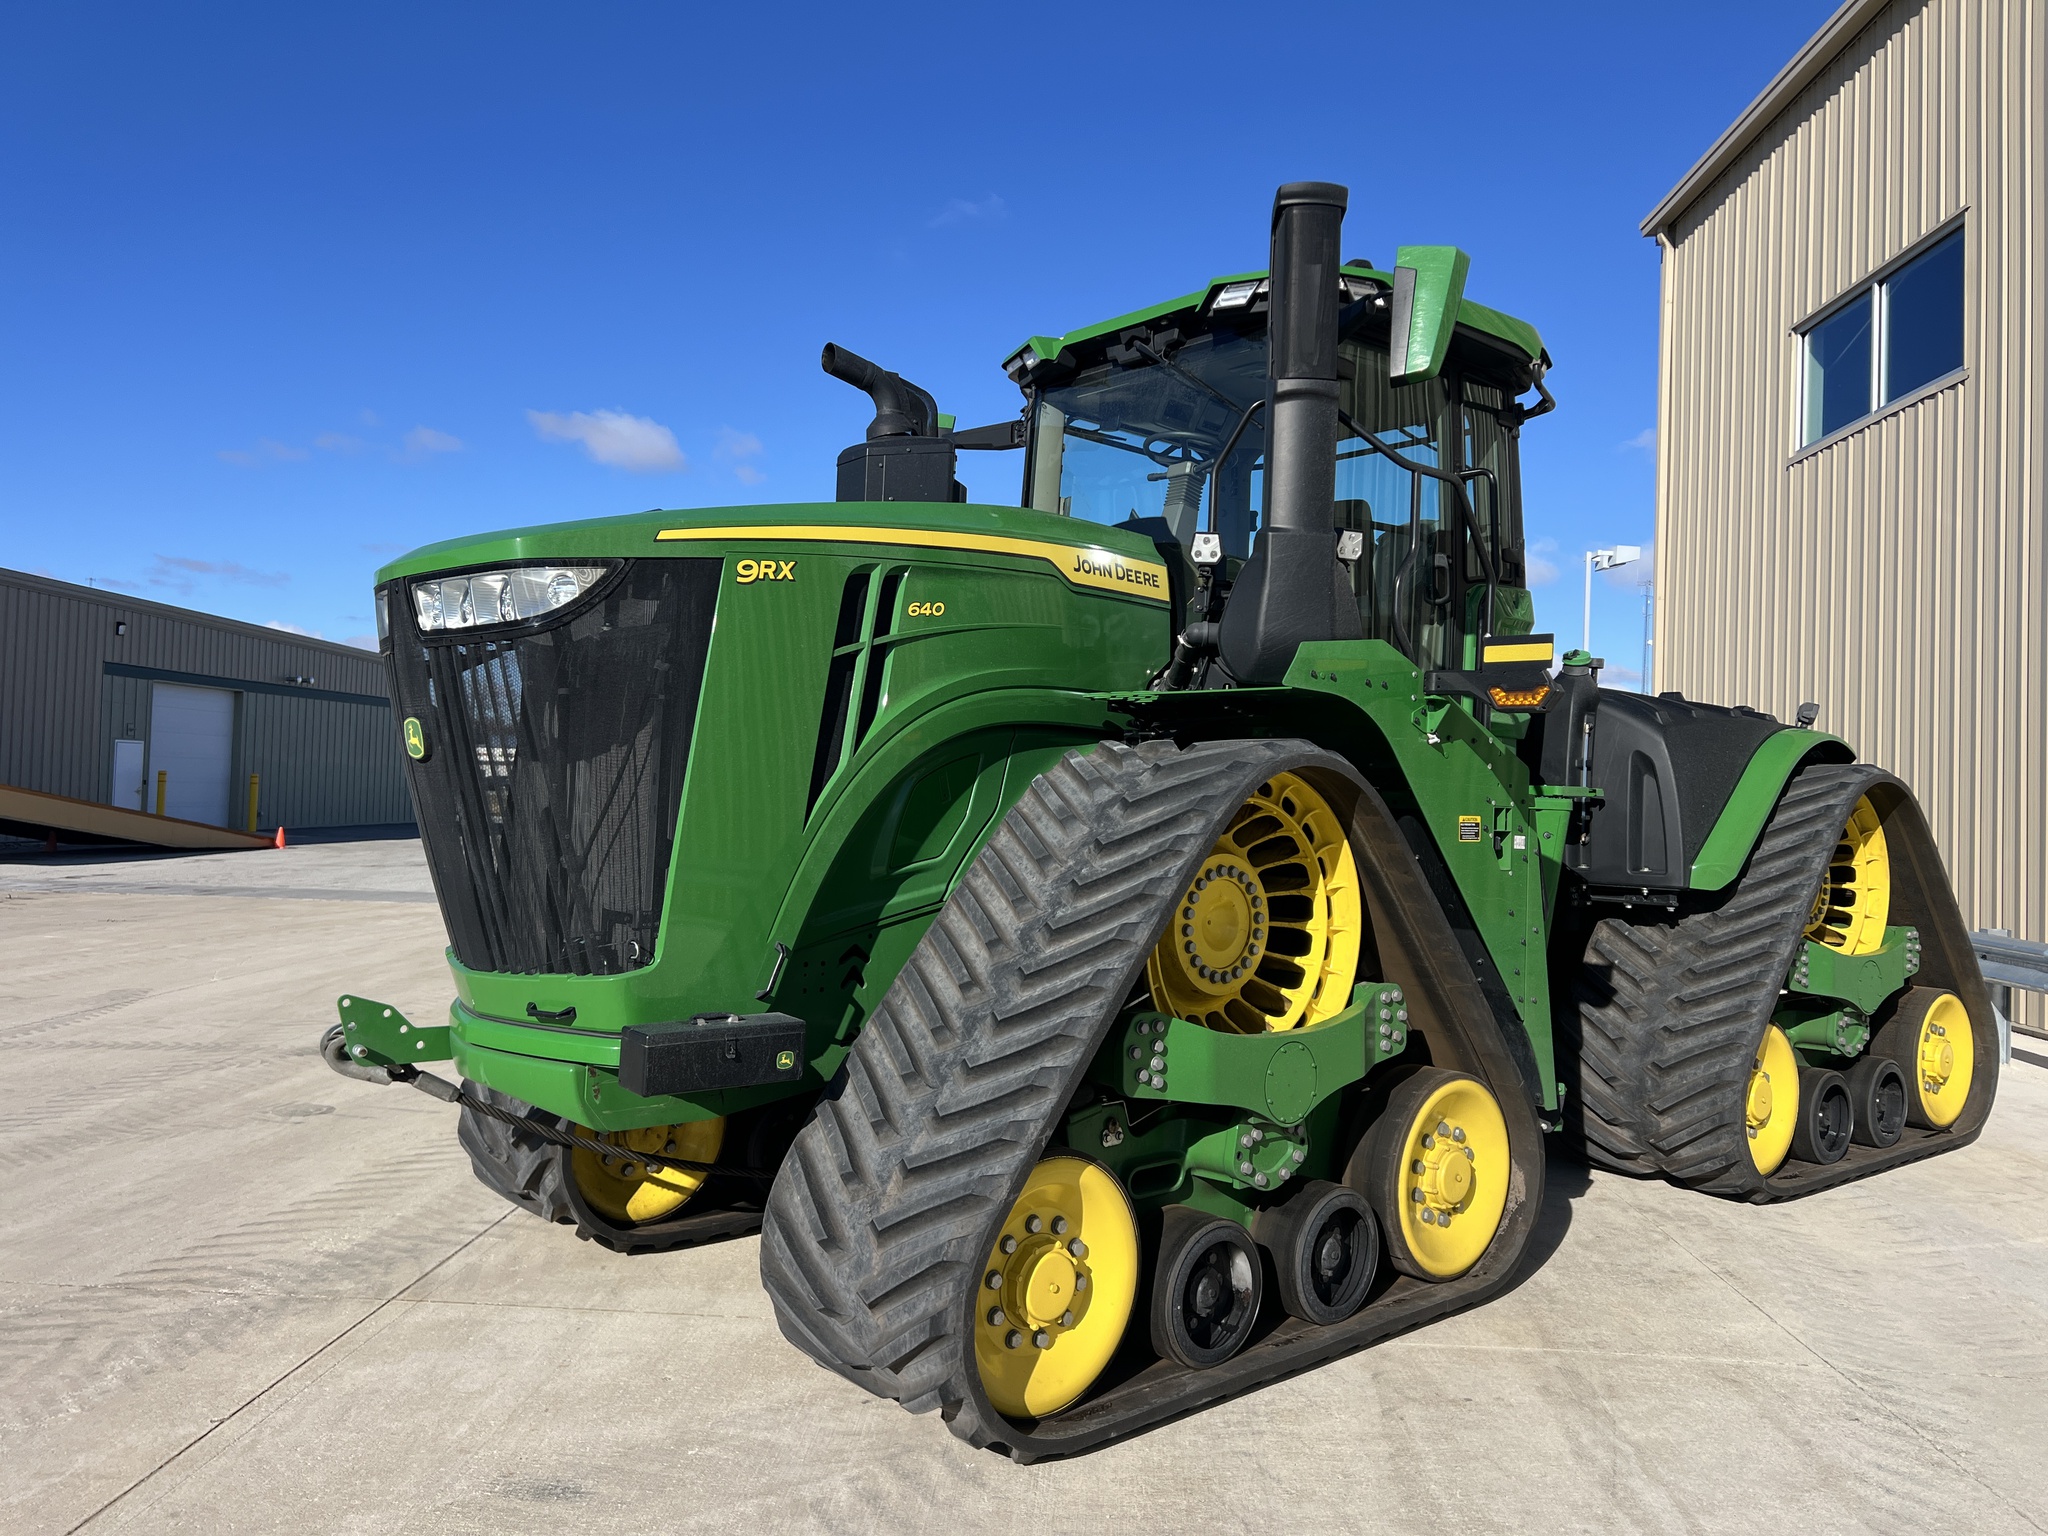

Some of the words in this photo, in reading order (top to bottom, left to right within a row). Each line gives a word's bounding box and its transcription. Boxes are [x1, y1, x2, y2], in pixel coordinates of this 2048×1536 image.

[736, 559, 797, 584] 9RX
[1073, 555, 1113, 578] JOHN
[1115, 563, 1160, 588] DEERE
[907, 601, 945, 617] 640
